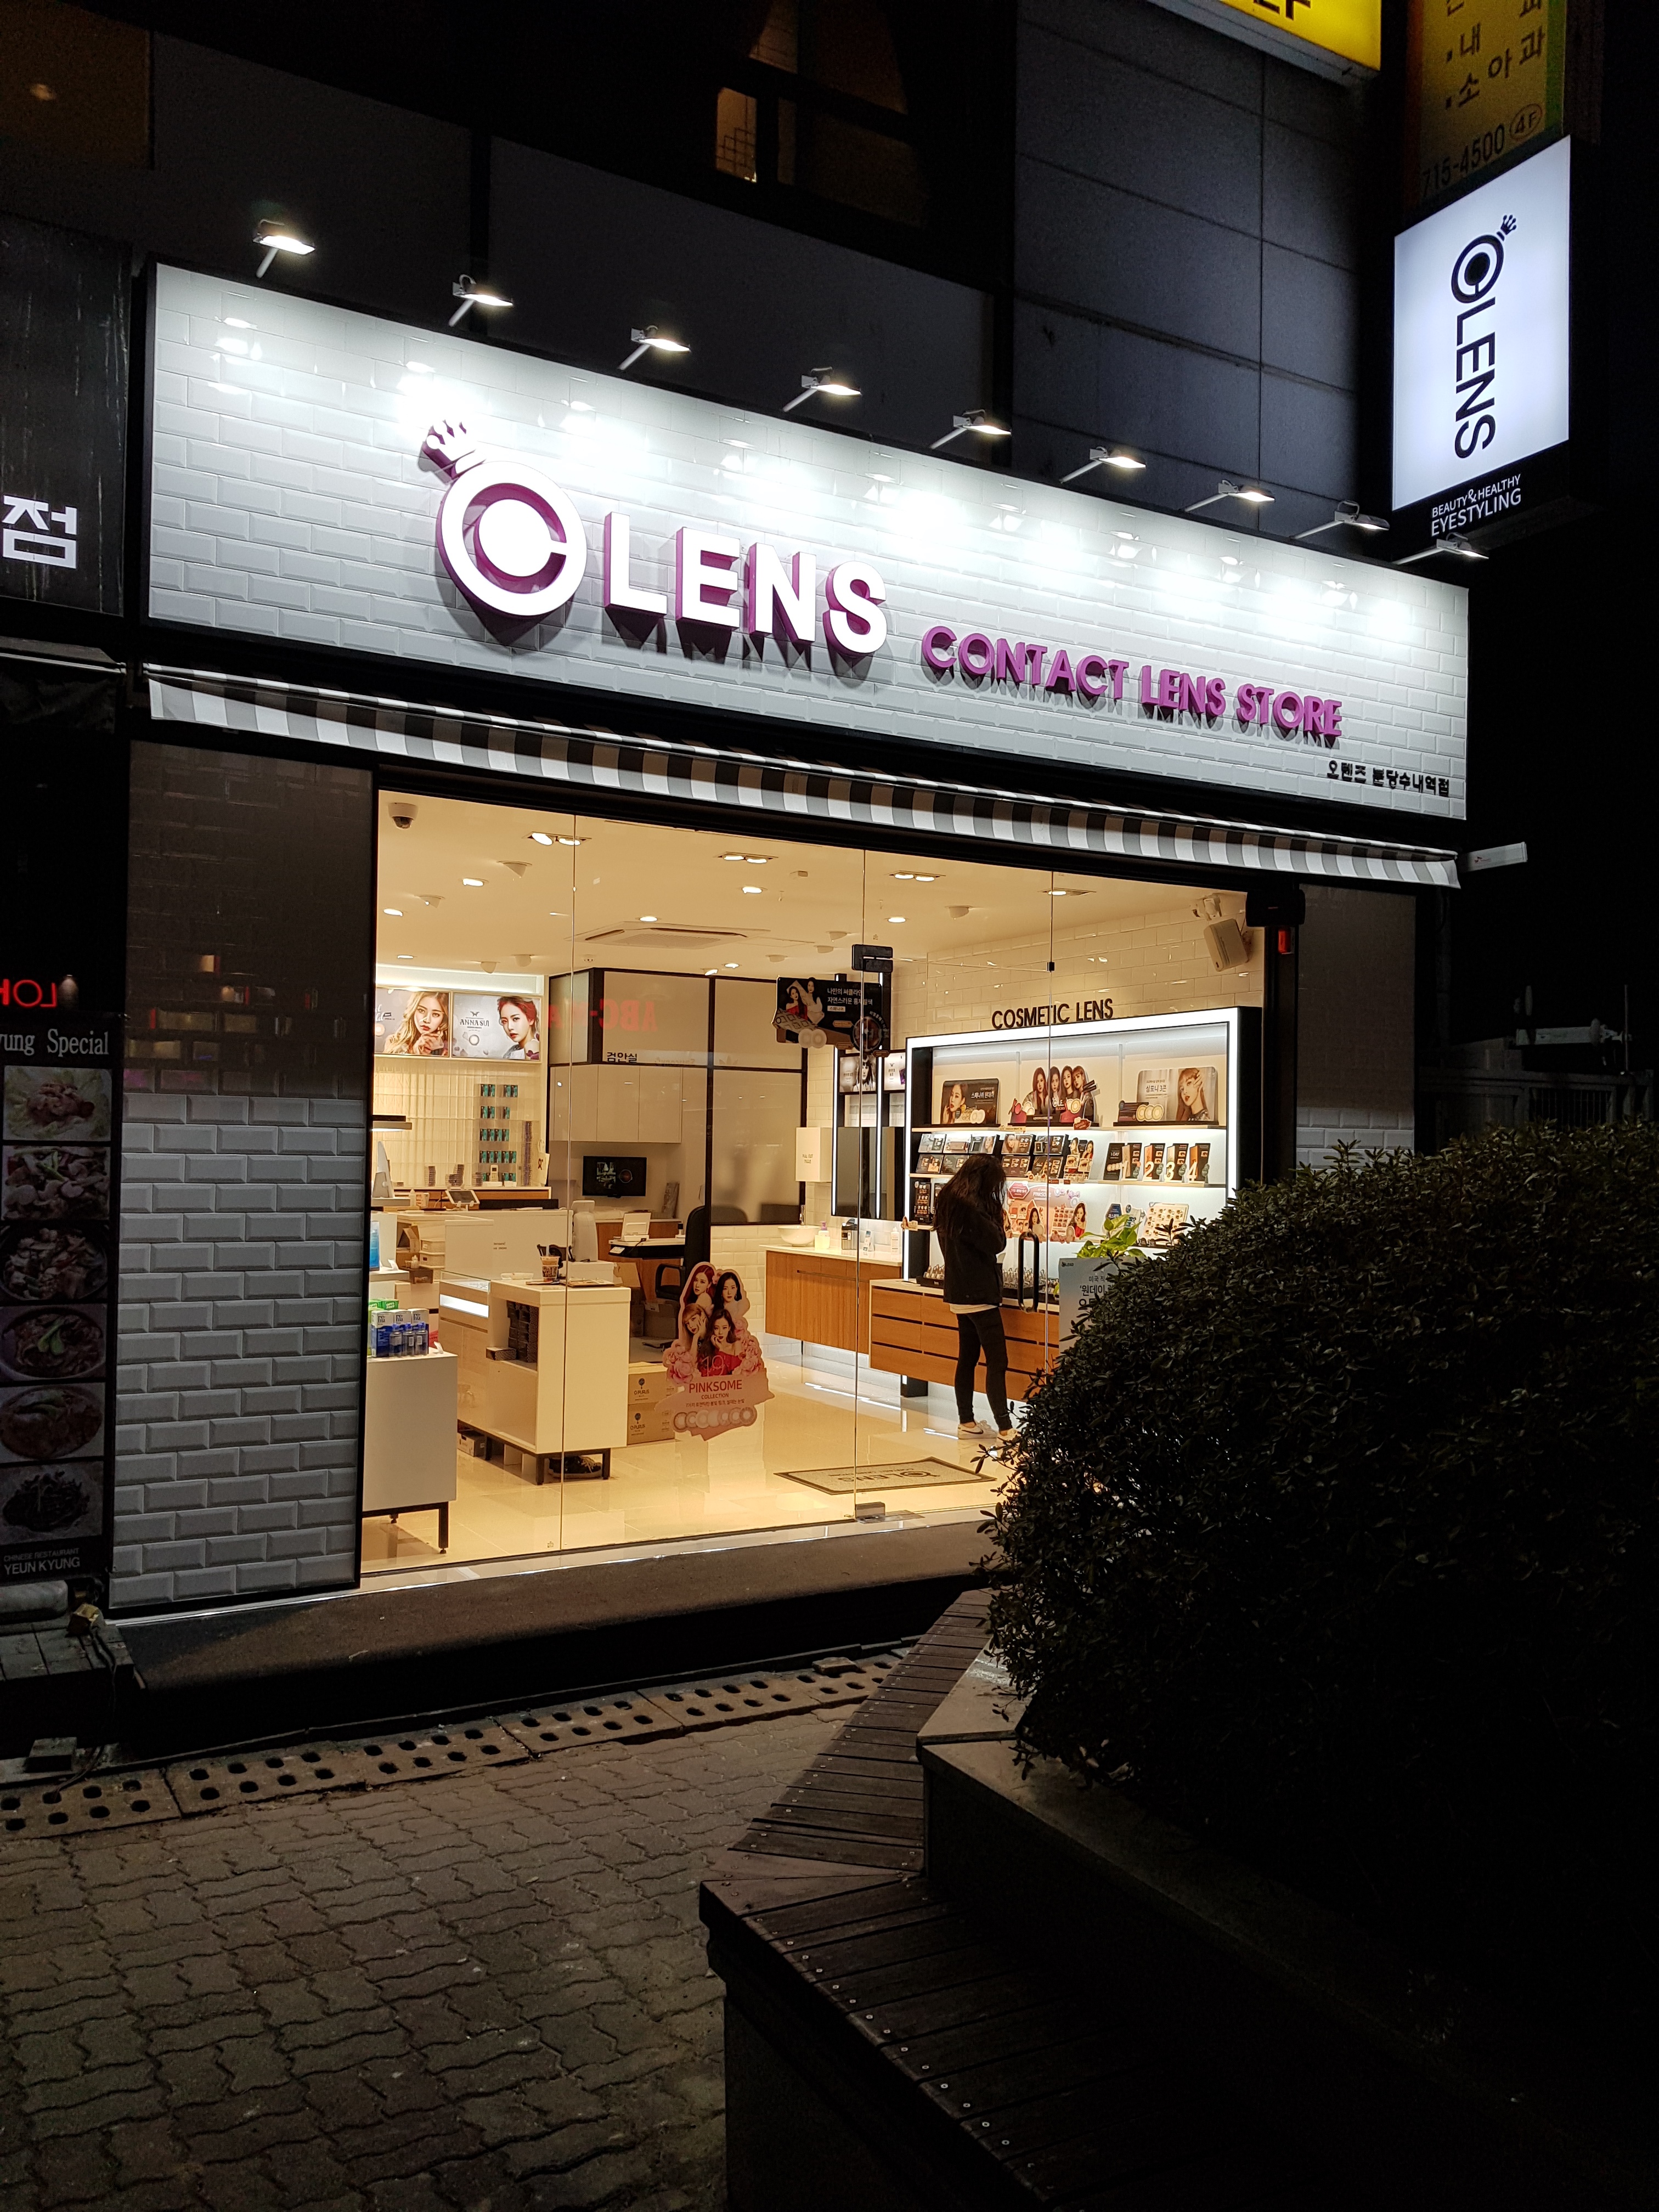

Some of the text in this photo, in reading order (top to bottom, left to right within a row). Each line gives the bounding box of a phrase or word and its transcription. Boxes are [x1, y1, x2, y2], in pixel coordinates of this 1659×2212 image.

[1451, 234, 1505, 459] OLENS
[2, 495, 77, 569] 점
[1431, 488, 1522, 537] EYESTYLING
[436, 460, 887, 656] OLENS
[921, 625, 1342, 738] CONTACT LENS STORE
[991, 998, 1113, 1030] COSMETIC LENS
[47, 1029, 109, 1058] Special
[607, 1052, 637, 1063] 검안실
[689, 1379, 742, 1393] PINKSOME
[4, 1556, 81, 1575] YEUN KYUNG
